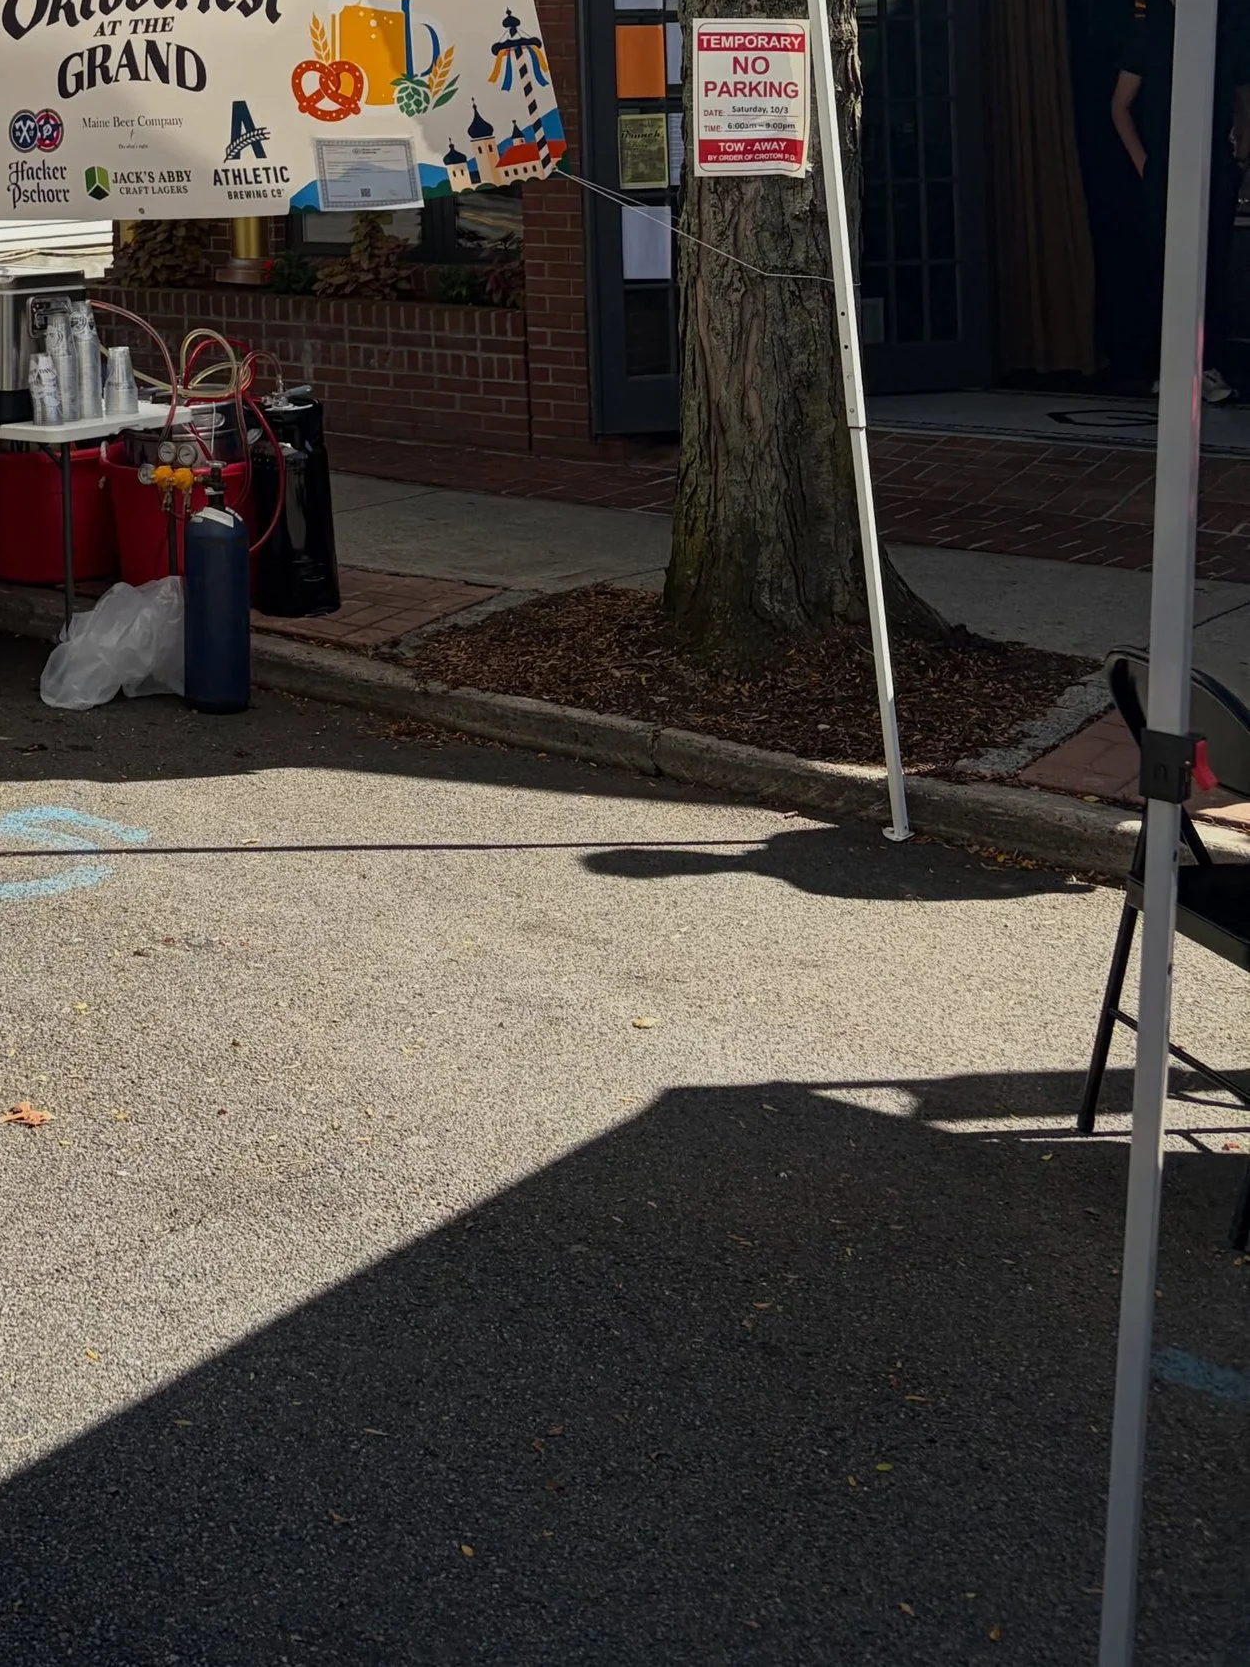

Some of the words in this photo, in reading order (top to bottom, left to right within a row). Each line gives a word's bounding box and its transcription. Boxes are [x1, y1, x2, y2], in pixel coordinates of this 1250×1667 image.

[93, 20, 122, 38] AT
[129, 16, 175, 35] THE
[700, 35, 802, 49] TEMPORARY
[57, 38, 207, 99] GRAND
[732, 56, 770, 75] NO
[704, 81, 799, 99] PARKING
[732, 106, 768, 114] Saturday,
[82, 117, 110, 128] Maine
[113, 116, 135, 128] Beer
[137, 115, 183, 129] Company
[704, 125, 723, 133] TIME:
[728, 122, 757, 130] 6:00am
[766, 122, 796, 131] 9:00pm
[718, 142, 745, 152] TOW
[753, 141, 787, 152] AWAY
[8, 159, 67, 184] Hacker
[112, 171, 155, 184] JACK'S
[158, 170, 192, 183] ABBY
[213, 165, 290, 186] ATHLETIC
[6, 182, 70, 209] Pschorr
[119, 186, 149, 195] CRAFT
[152, 185, 189, 195] LAGERS
[227, 189, 268, 200] BREWING
